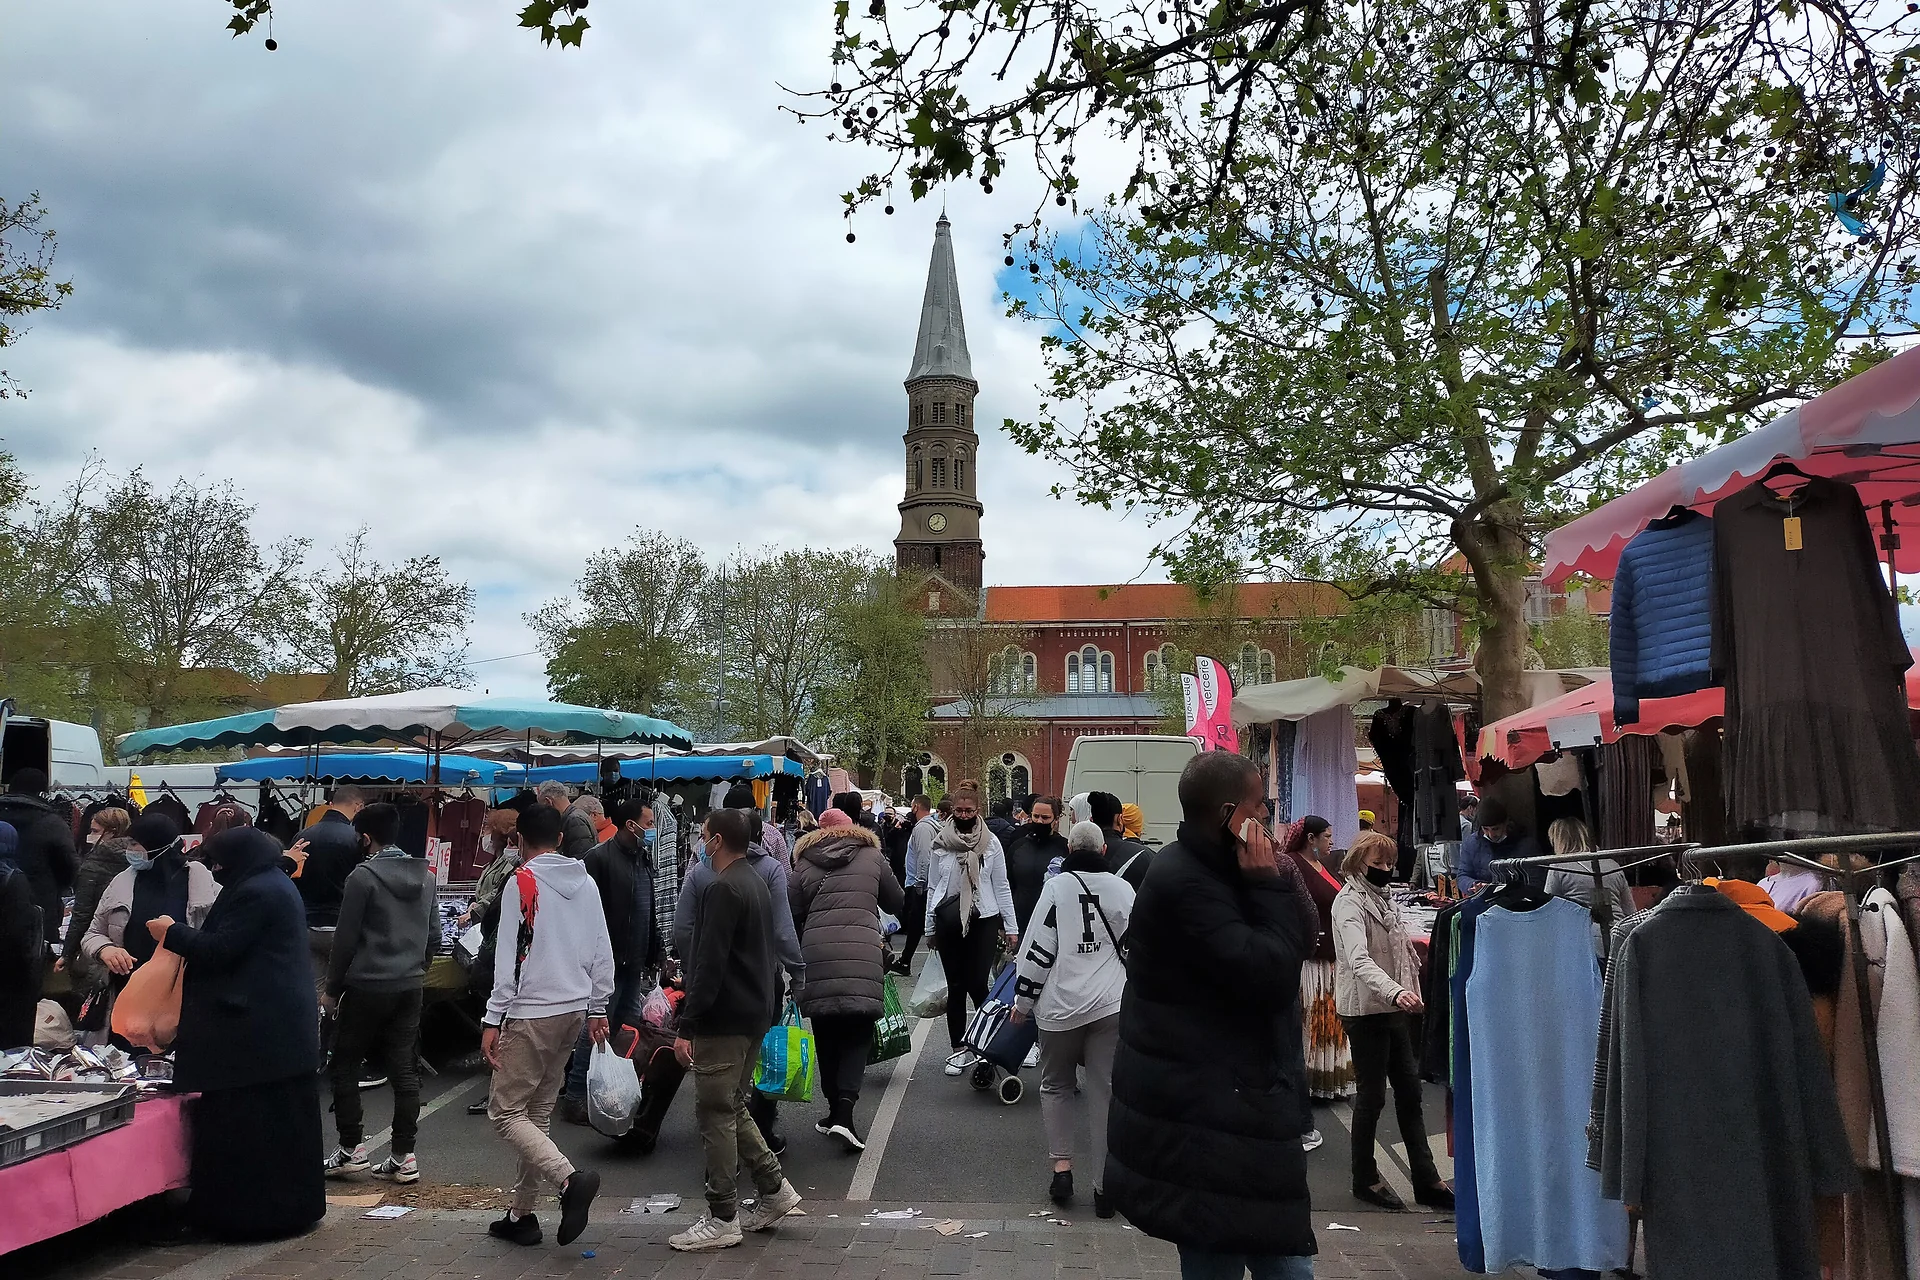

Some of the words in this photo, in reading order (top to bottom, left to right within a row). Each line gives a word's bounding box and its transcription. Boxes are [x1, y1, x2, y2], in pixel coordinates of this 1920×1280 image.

[1201, 659, 1213, 710] mercerie
[1078, 894, 1100, 942] F
[1077, 942, 1102, 954] NEW
